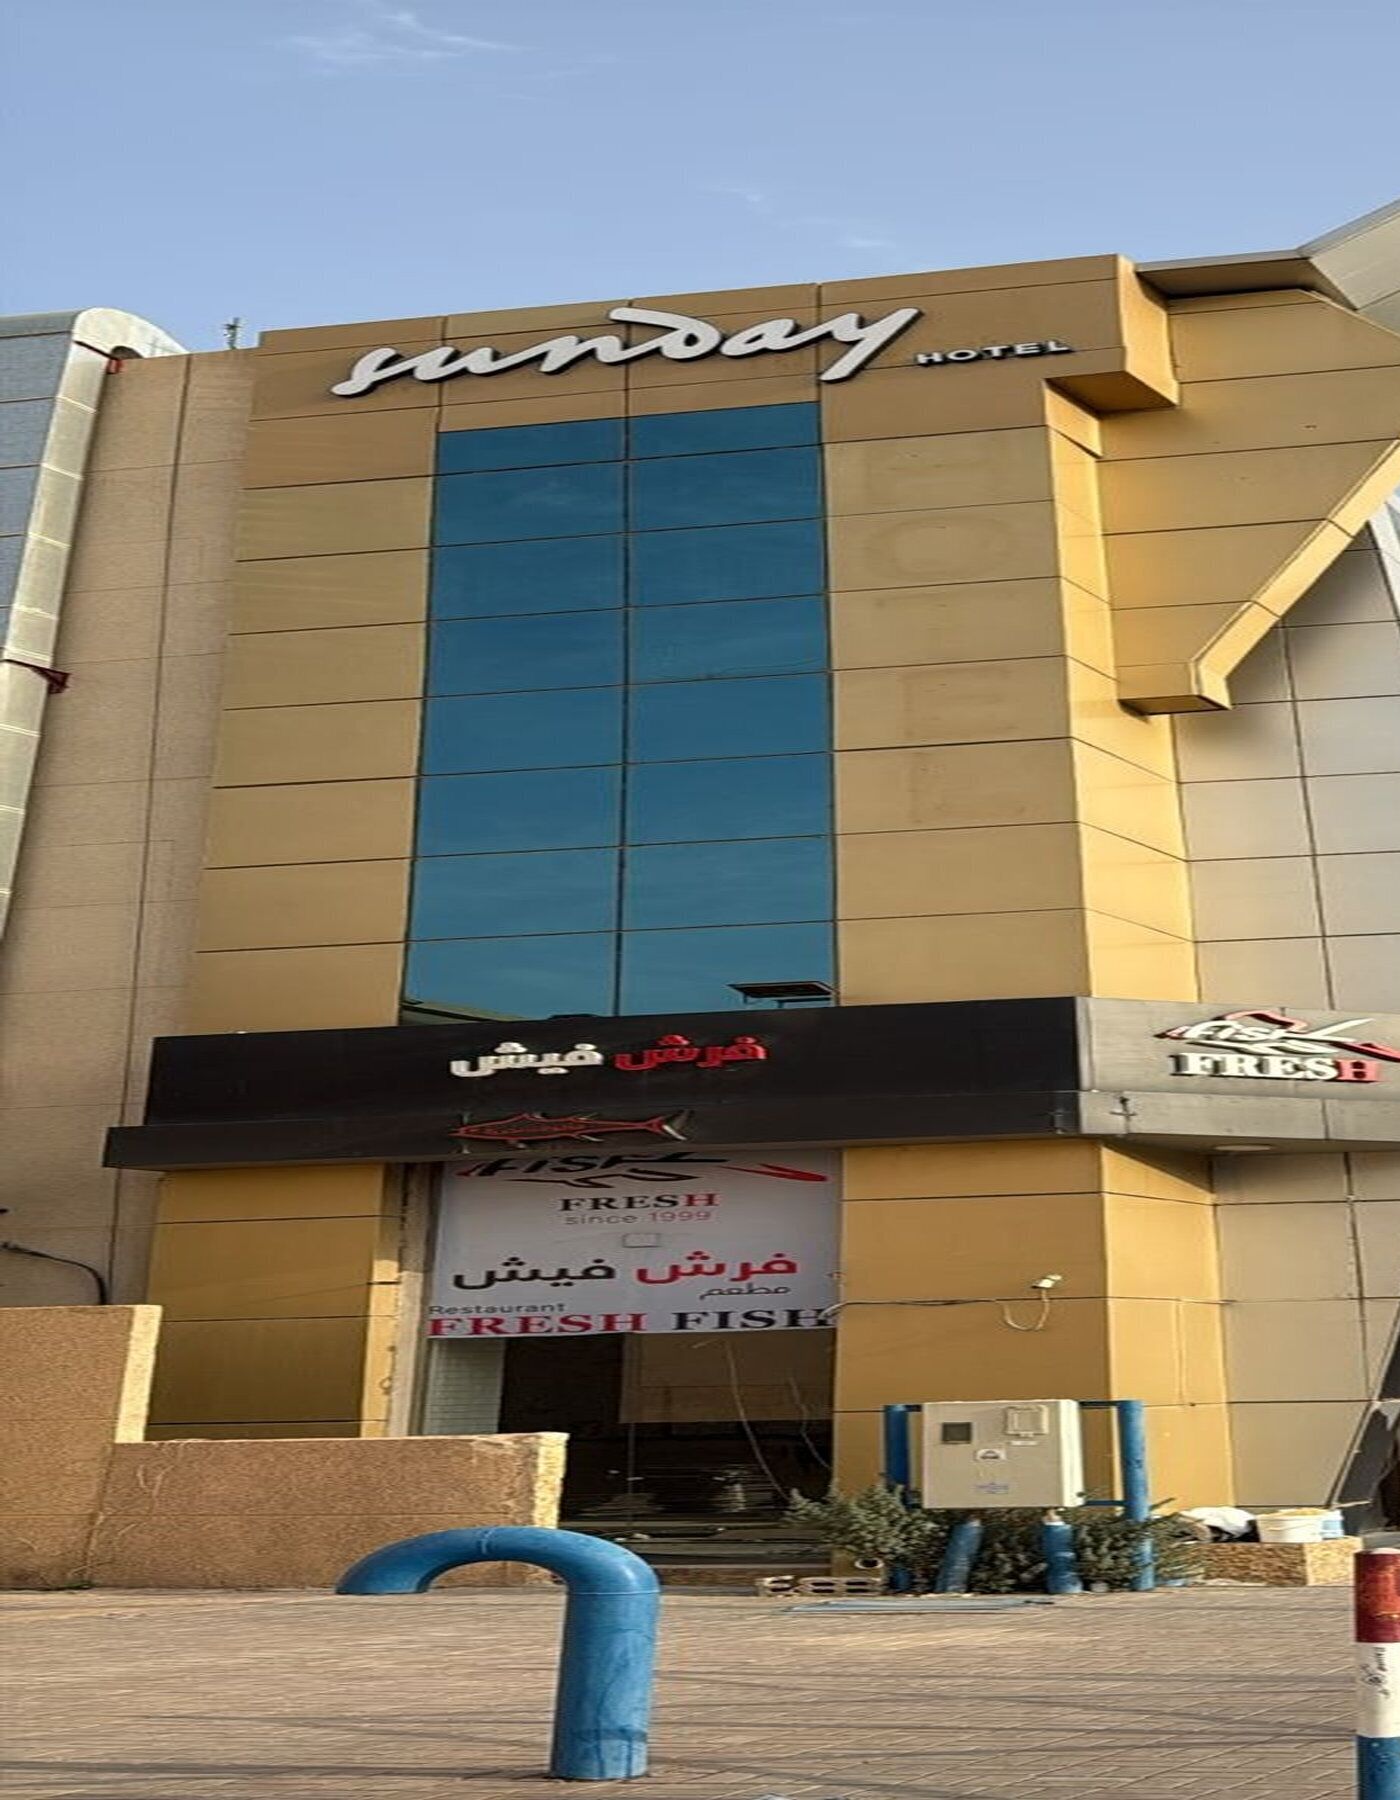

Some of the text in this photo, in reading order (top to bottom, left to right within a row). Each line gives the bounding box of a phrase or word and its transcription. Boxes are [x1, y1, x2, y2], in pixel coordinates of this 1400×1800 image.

[332, 307, 1073, 396] sunday HOTEL
[450, 1034, 767, 1078] فرش فيش
[1172, 1052, 1381, 1081] FRESH
[558, 1193, 720, 1211] FRESH
[564, 1210, 712, 1225] since 1999
[453, 1251, 798, 1290] فرش فيش
[699, 1282, 791, 1300] مطعم
[427, 1309, 837, 1336] FRESH FISH
[428, 1303, 566, 1315] Restaurant
